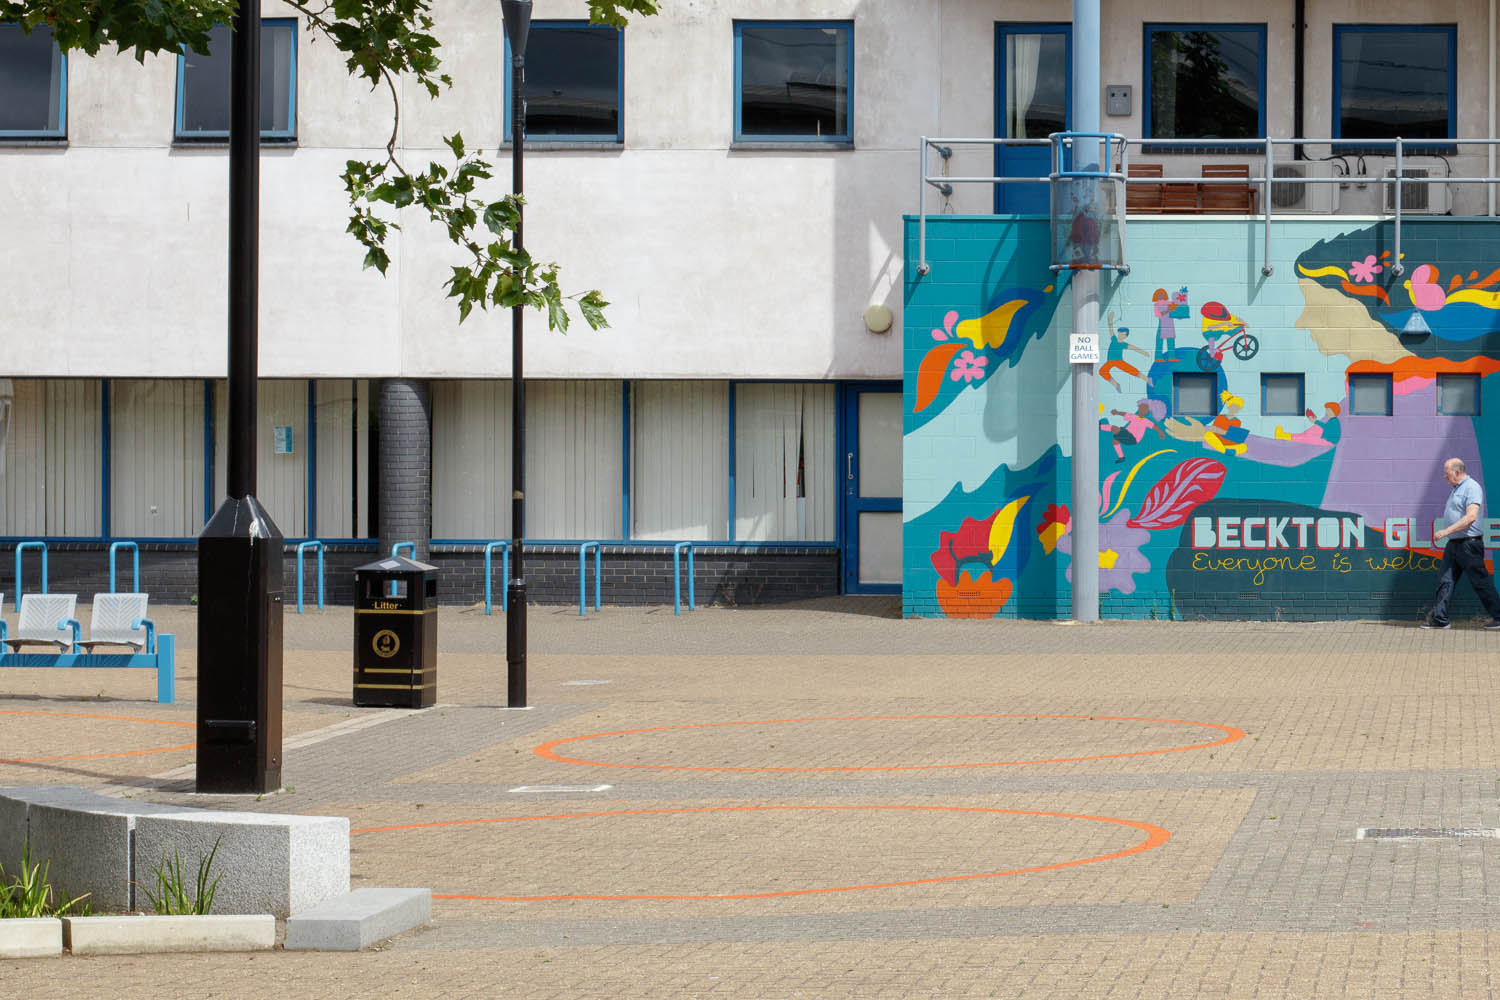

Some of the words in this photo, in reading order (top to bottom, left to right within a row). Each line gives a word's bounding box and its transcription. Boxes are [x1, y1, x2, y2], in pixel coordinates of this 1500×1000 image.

[1192, 516, 1365, 550] BECKTON
[1192, 552, 1317, 586] Everyone
[1332, 552, 1353, 573] is
[374, 601, 399, 609] Litter
